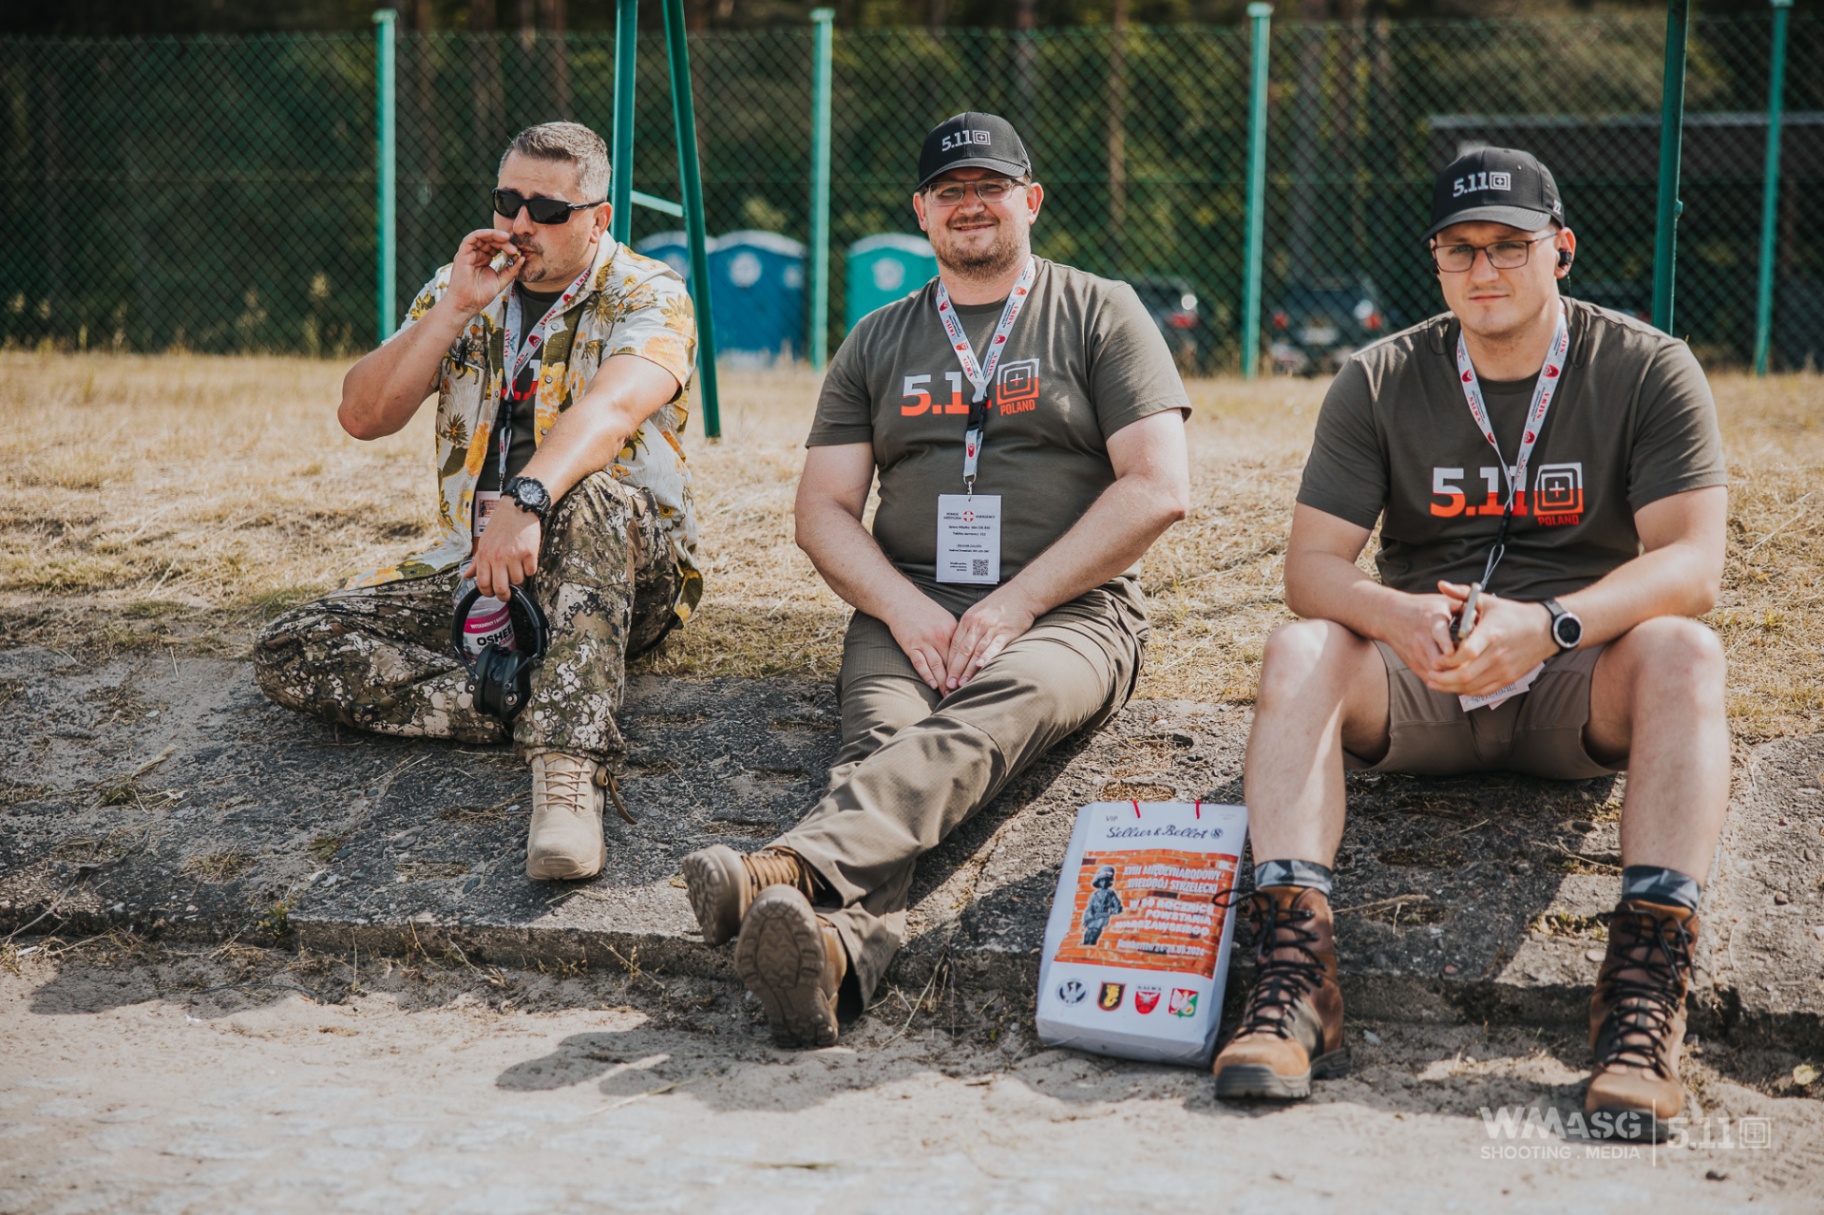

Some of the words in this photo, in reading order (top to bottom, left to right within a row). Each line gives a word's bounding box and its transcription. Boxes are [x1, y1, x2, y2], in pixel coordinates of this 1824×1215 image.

[942, 130, 972, 152] 5.11
[1452, 172, 1489, 198] 5.11
[1000, 399, 1036, 417] POLAND
[1537, 514, 1580, 527] POLAND
[1106, 826, 1151, 839] Sellier
[1153, 826, 1160, 836] &
[1161, 824, 1208, 839] Bellot
[1170, 879, 1218, 894] STRZELECKI
[1145, 909, 1211, 925] POWSTANIA
